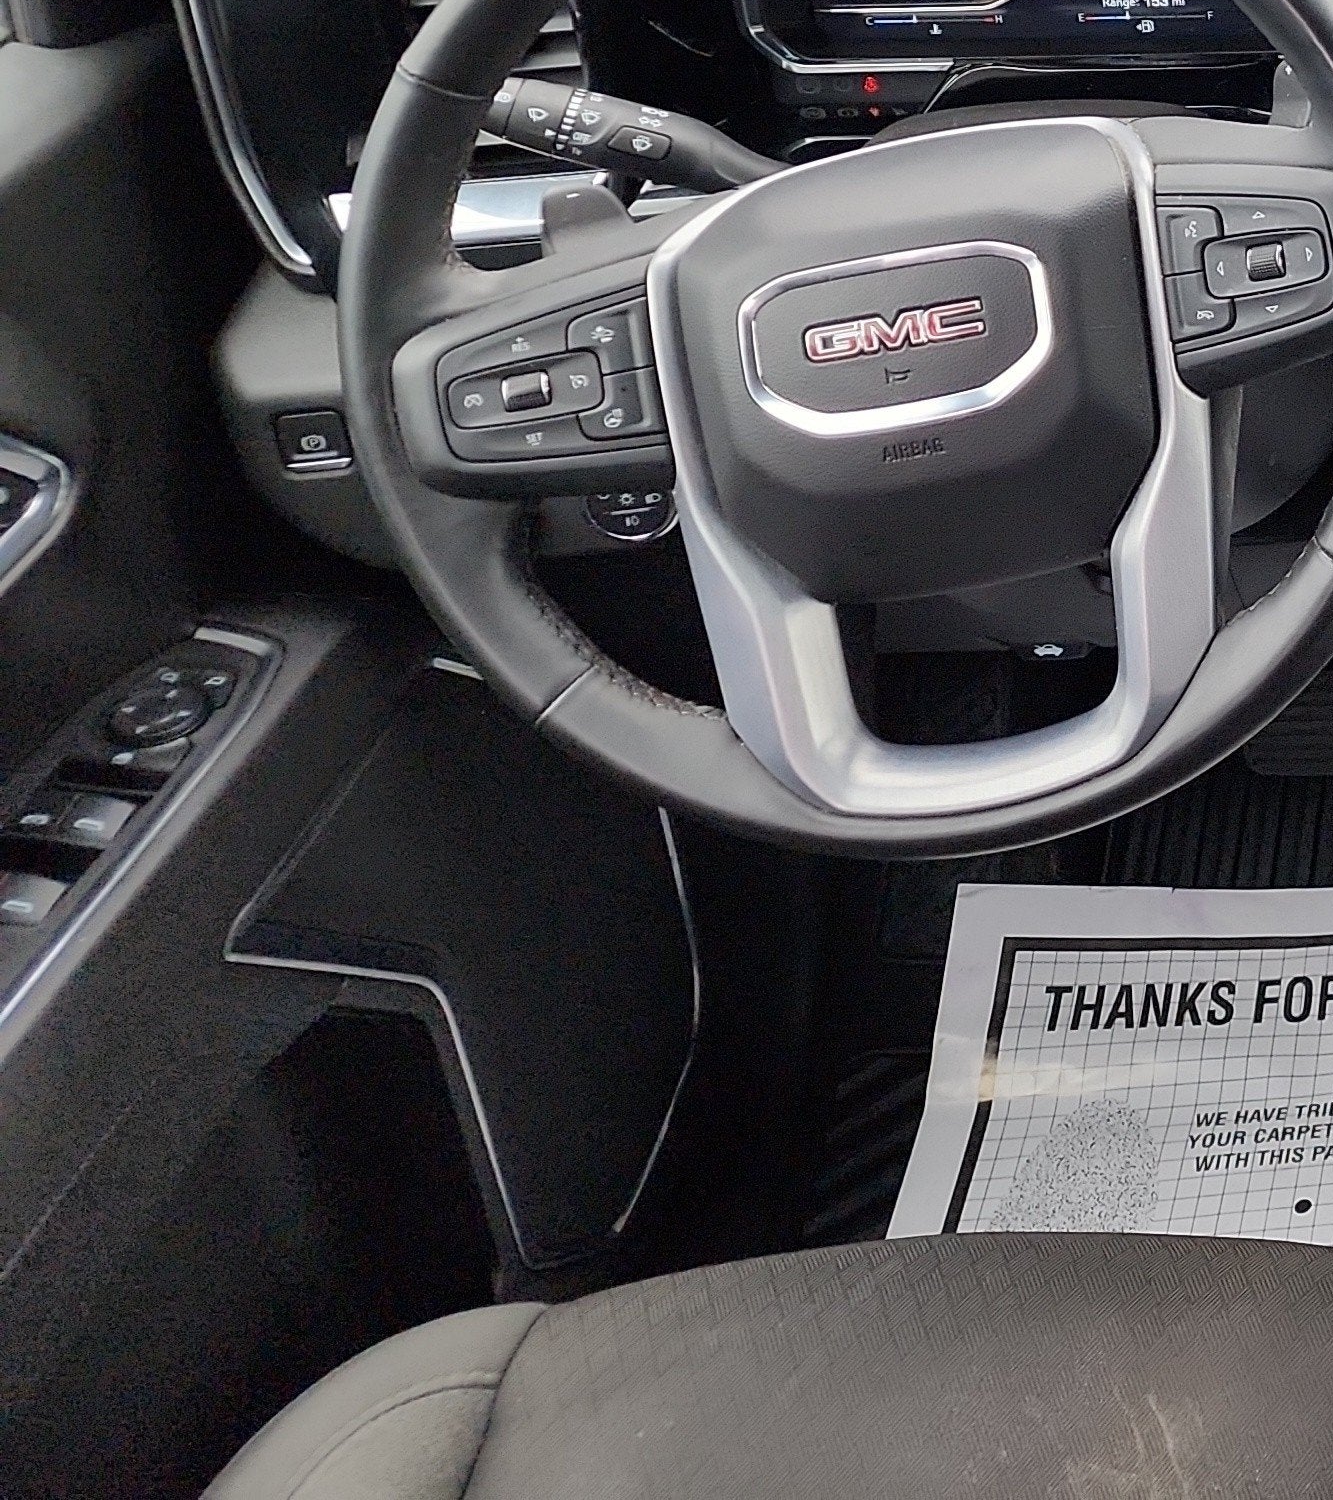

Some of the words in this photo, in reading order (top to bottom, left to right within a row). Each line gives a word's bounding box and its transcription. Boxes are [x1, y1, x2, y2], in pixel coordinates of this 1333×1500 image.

[1077, 12, 1086, 23] E
[1206, 10, 1214, 20] F
[804, 298, 986, 363] GMC
[882, 437, 946, 463] AIRBAG
[1045, 980, 1236, 1032] THANKS
[1196, 1111, 1228, 1128] WE
[1234, 1106, 1288, 1125] HAVE
[1188, 1130, 1247, 1150] YOUR
[1195, 1152, 1249, 1172] WITH
[1257, 1147, 1305, 1166] THIS
